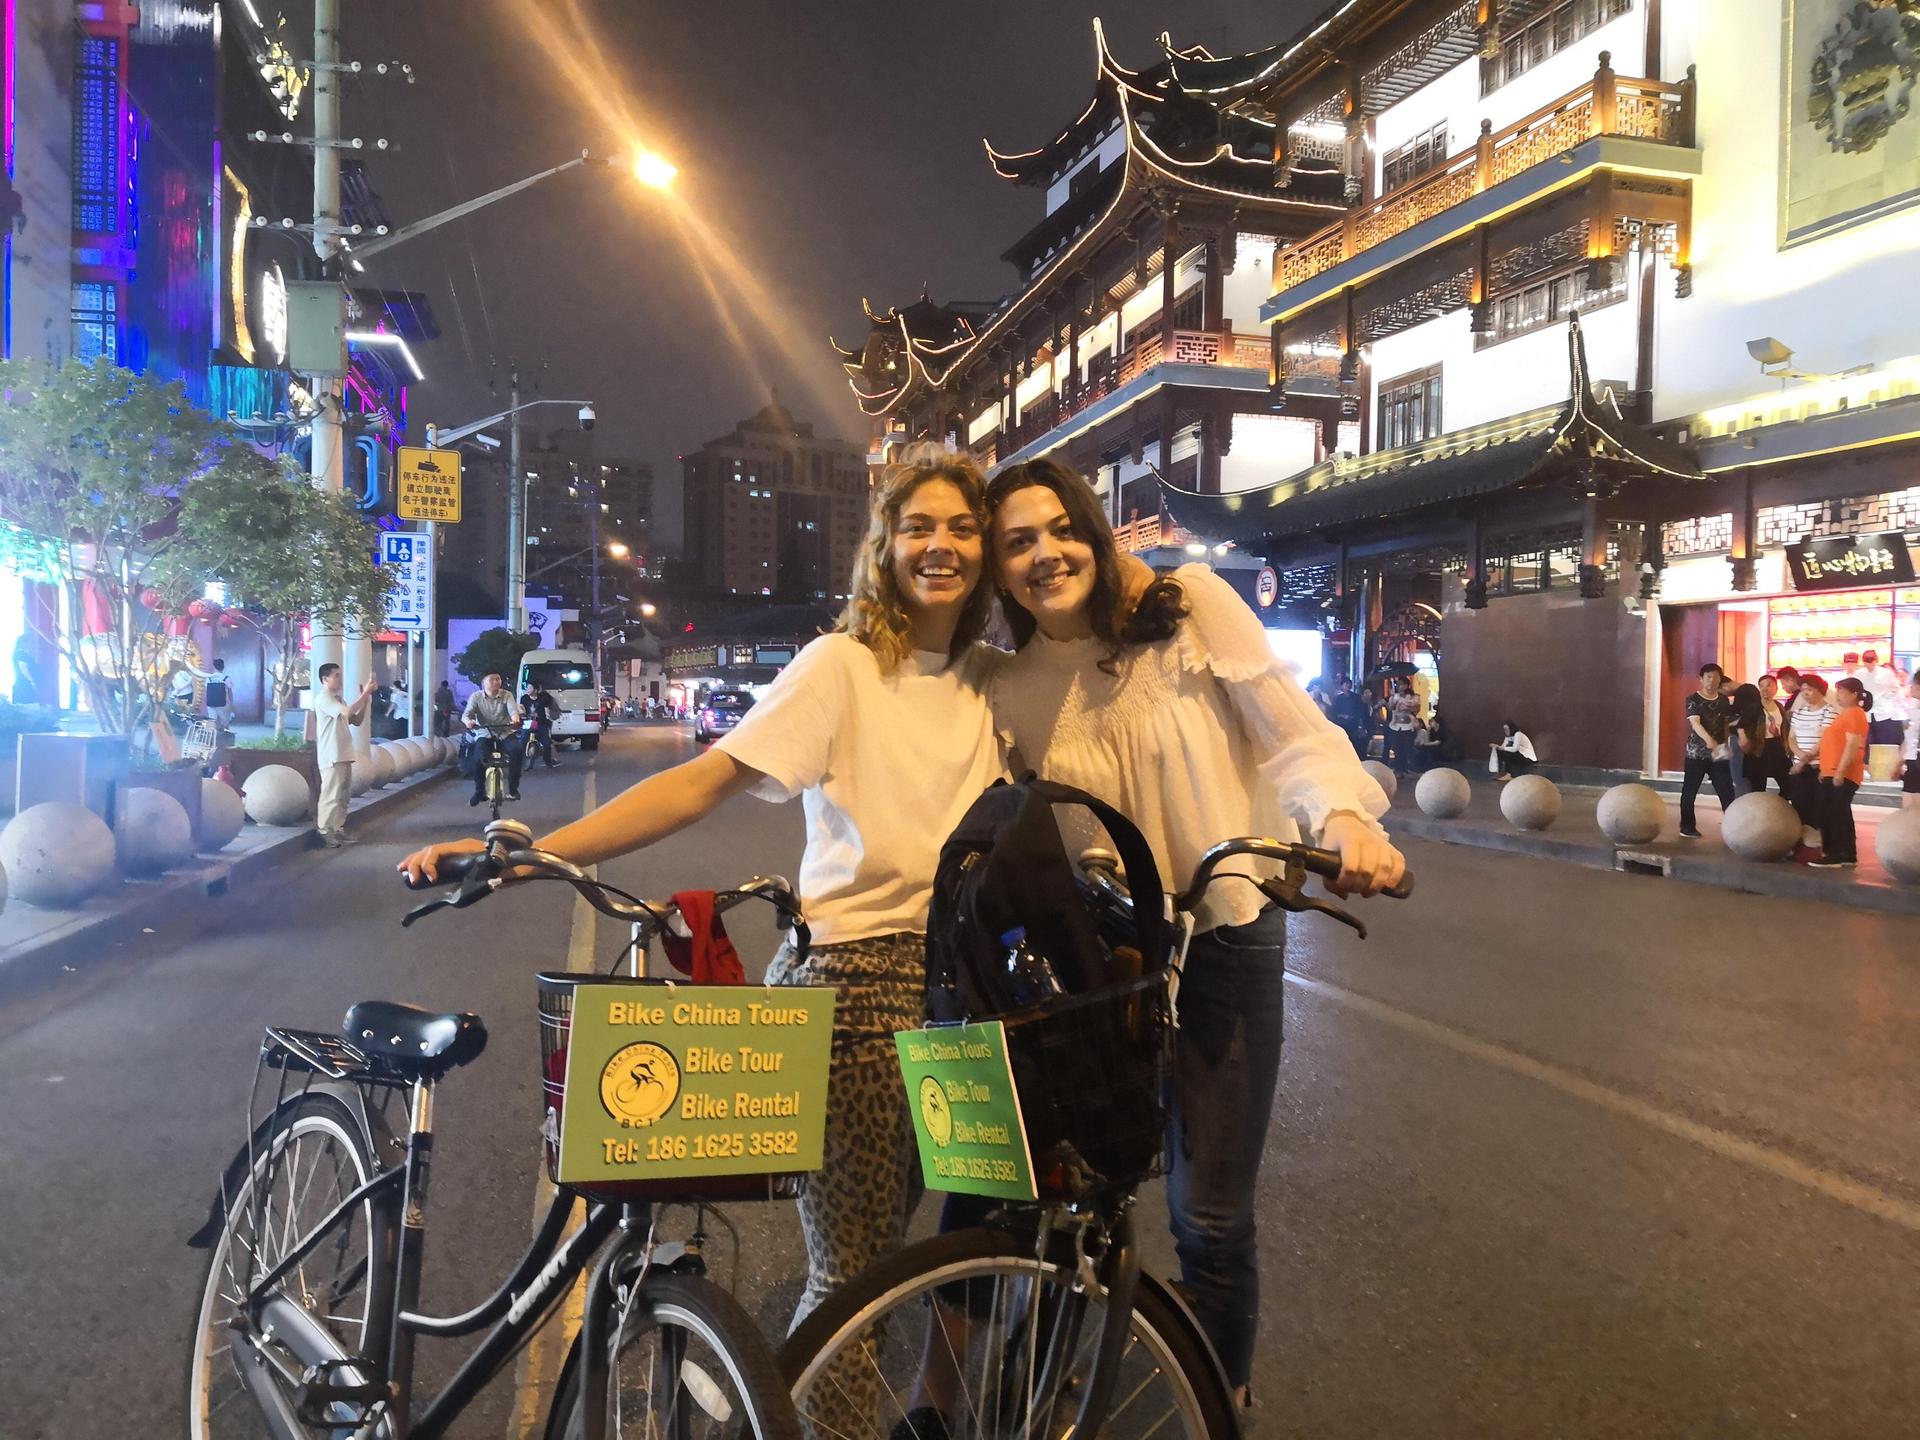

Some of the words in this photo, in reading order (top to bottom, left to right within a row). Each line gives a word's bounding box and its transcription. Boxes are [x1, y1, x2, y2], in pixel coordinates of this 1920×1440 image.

[403, 472, 456, 485] 停车行为违法
[407, 484, 451, 496] 请立即驶离
[403, 496, 457, 507] 电子警察监管
[608, 1002, 665, 1025] Bike
[673, 1003, 741, 1025] China
[747, 1004, 808, 1025] Tours
[686, 1047, 733, 1073] Bike
[738, 1047, 783, 1073] Tour
[907, 1044, 931, 1062] Bike
[931, 1043, 961, 1061] China
[960, 1040, 992, 1058] Tours
[945, 1081, 969, 1103] Bike
[967, 1080, 991, 1102] Tour
[681, 1093, 728, 1119] Bike
[734, 1091, 800, 1117] Rental
[954, 1120, 977, 1144] Bike
[976, 1121, 1011, 1145] Rental
[603, 1138, 638, 1163] Tel:
[646, 1135, 687, 1161] 186
[692, 1133, 744, 1159] 1625
[749, 1131, 798, 1155] 3582
[933, 1156, 948, 1177] Tel:
[949, 1155, 968, 1177] 186
[968, 1157, 993, 1180] 1625
[992, 1159, 1018, 1182] 3582
